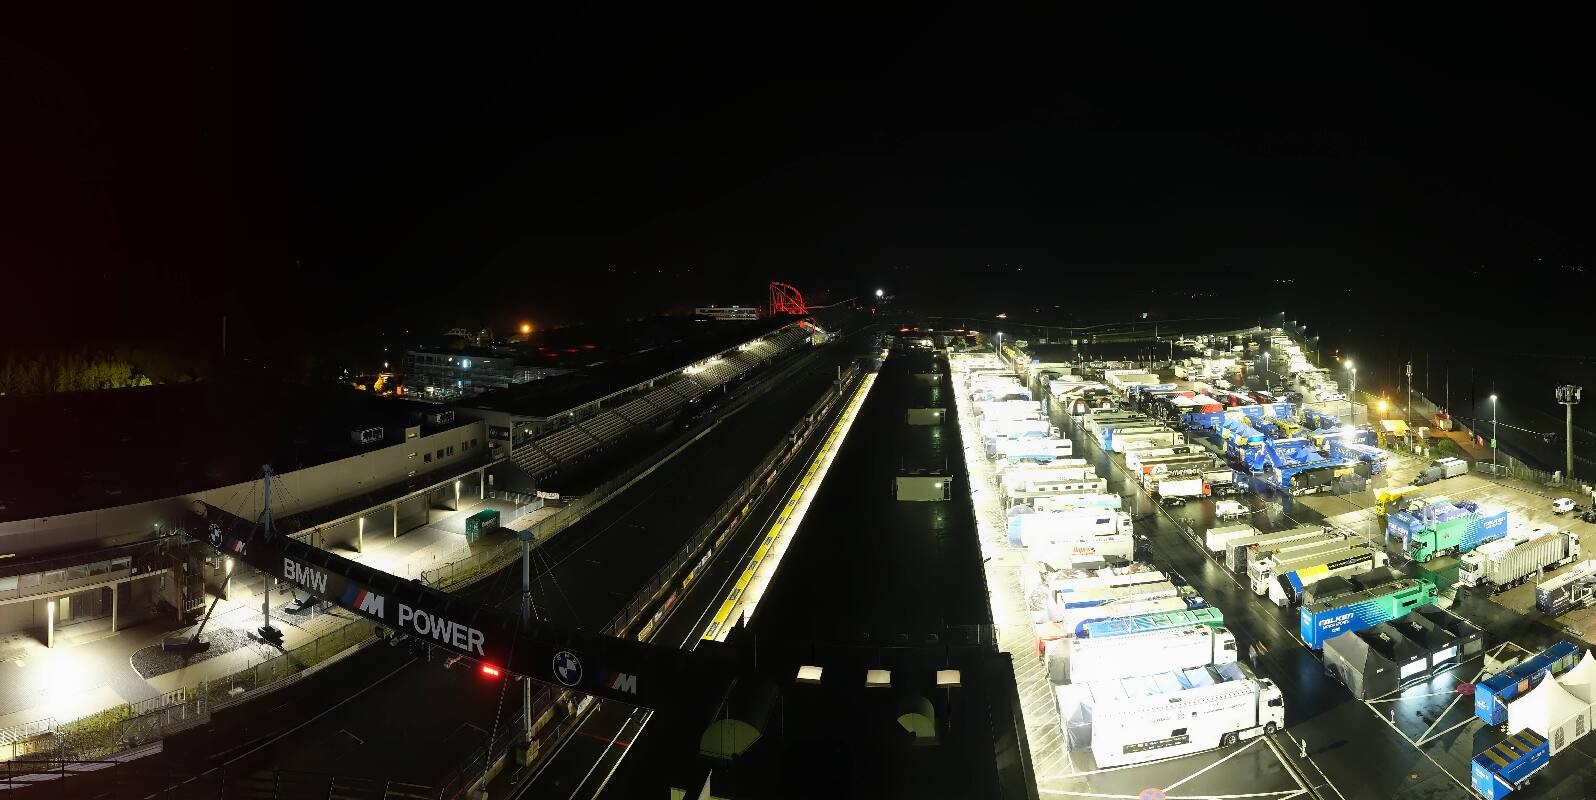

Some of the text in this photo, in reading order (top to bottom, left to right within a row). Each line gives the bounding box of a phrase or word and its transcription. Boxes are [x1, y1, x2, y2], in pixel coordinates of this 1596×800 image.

[283, 558, 485, 656] BMW M POWER
